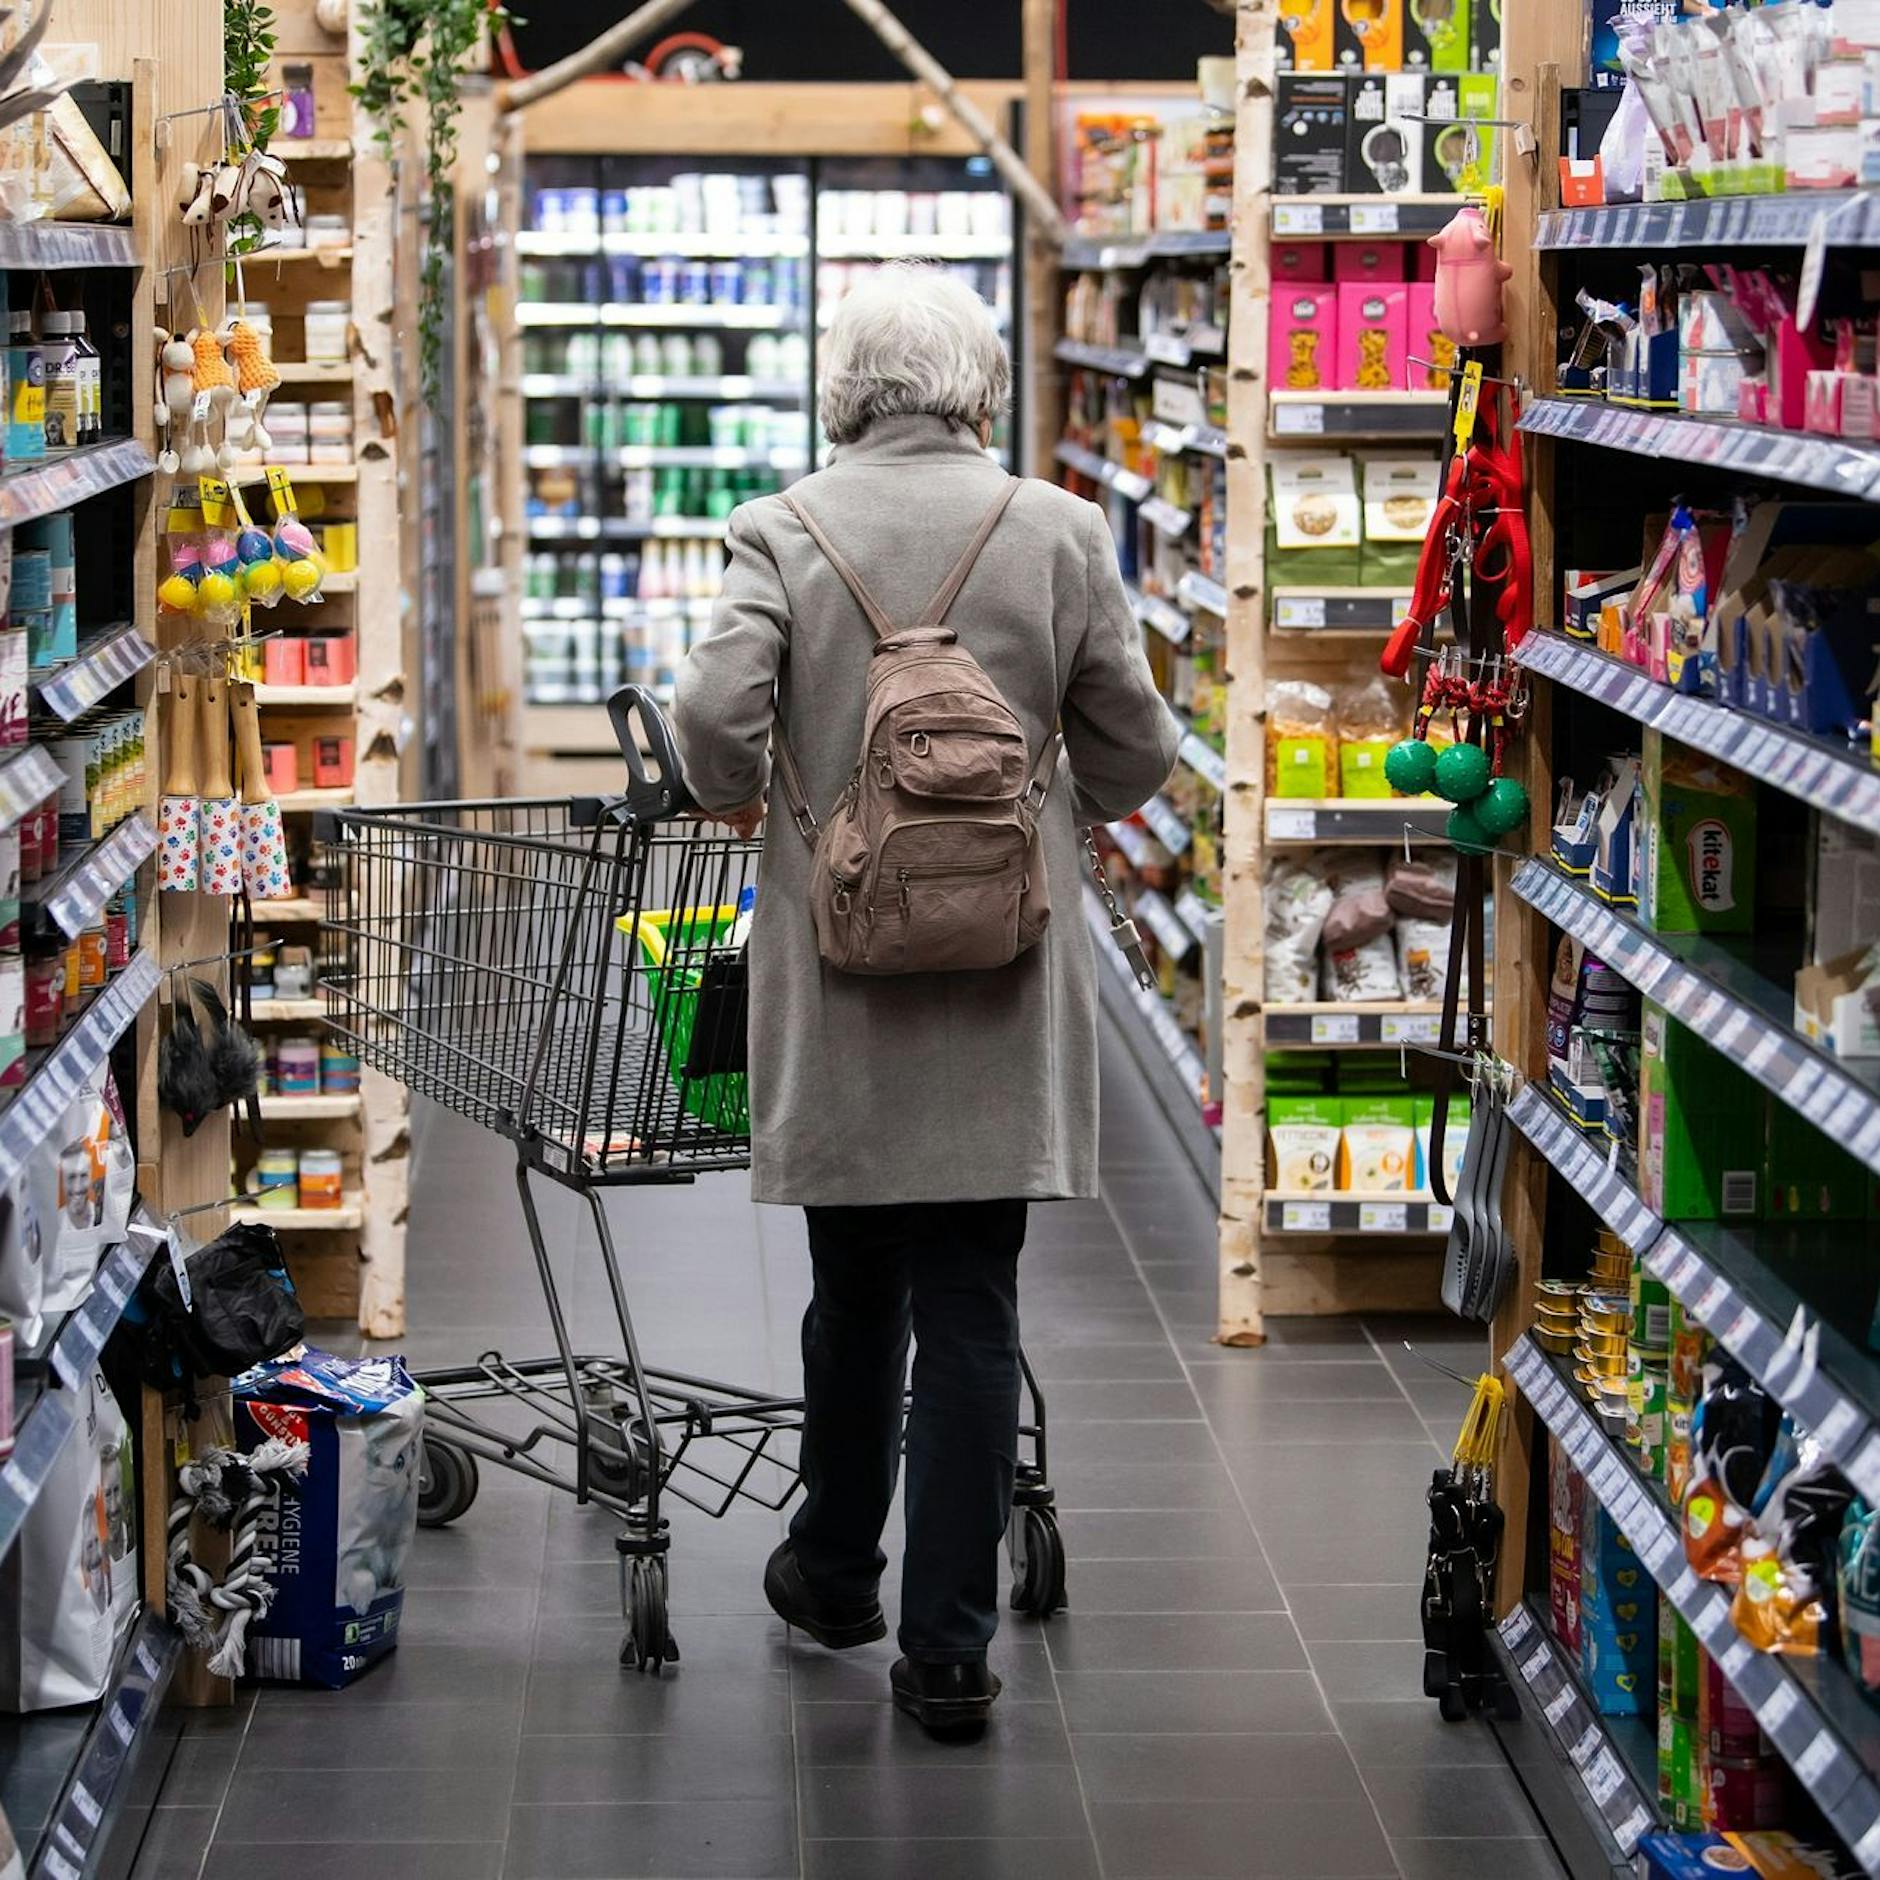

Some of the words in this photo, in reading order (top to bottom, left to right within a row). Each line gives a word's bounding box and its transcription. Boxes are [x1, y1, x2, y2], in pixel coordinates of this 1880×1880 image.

[1620, 3, 1677, 16] AUSSIEHT
[1702, 830, 1722, 899] kitekat
[281, 1493, 302, 1576] HYGIENE
[341, 1655, 356, 1671] 20
